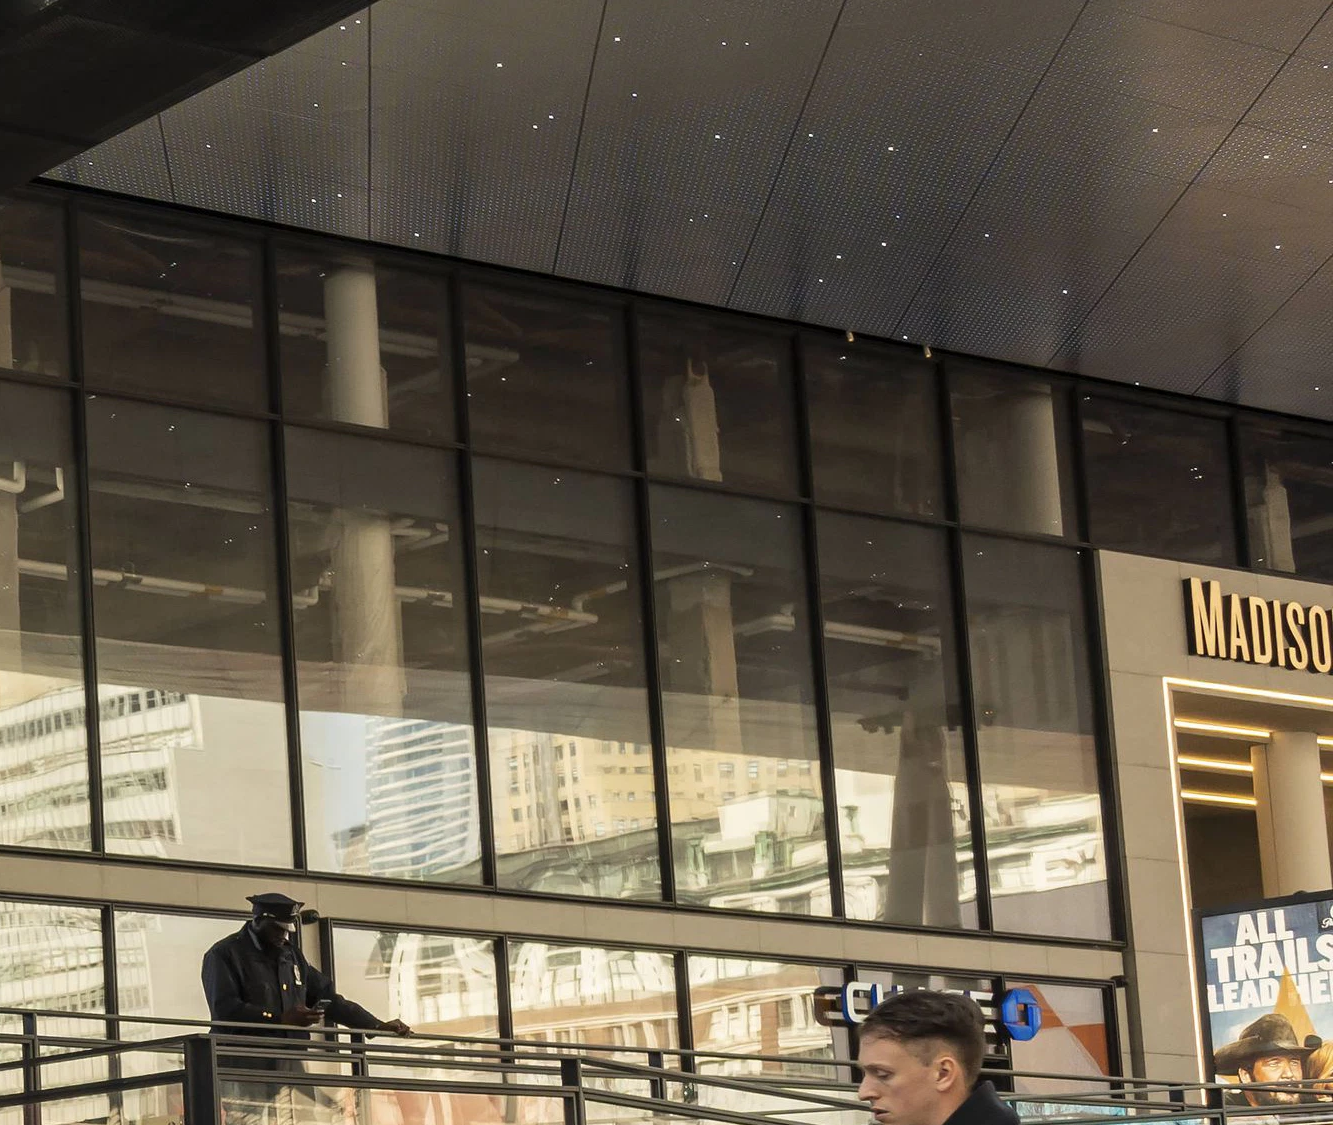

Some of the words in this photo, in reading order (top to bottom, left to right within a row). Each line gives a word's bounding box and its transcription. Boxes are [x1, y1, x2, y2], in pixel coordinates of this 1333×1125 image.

[1190, 576, 1333, 674] MADISO
[1236, 909, 1294, 946] ALL
[1210, 933, 1333, 984] TRAILS
[1207, 977, 1281, 1013] LEAD
[1292, 970, 1333, 1007] HE
